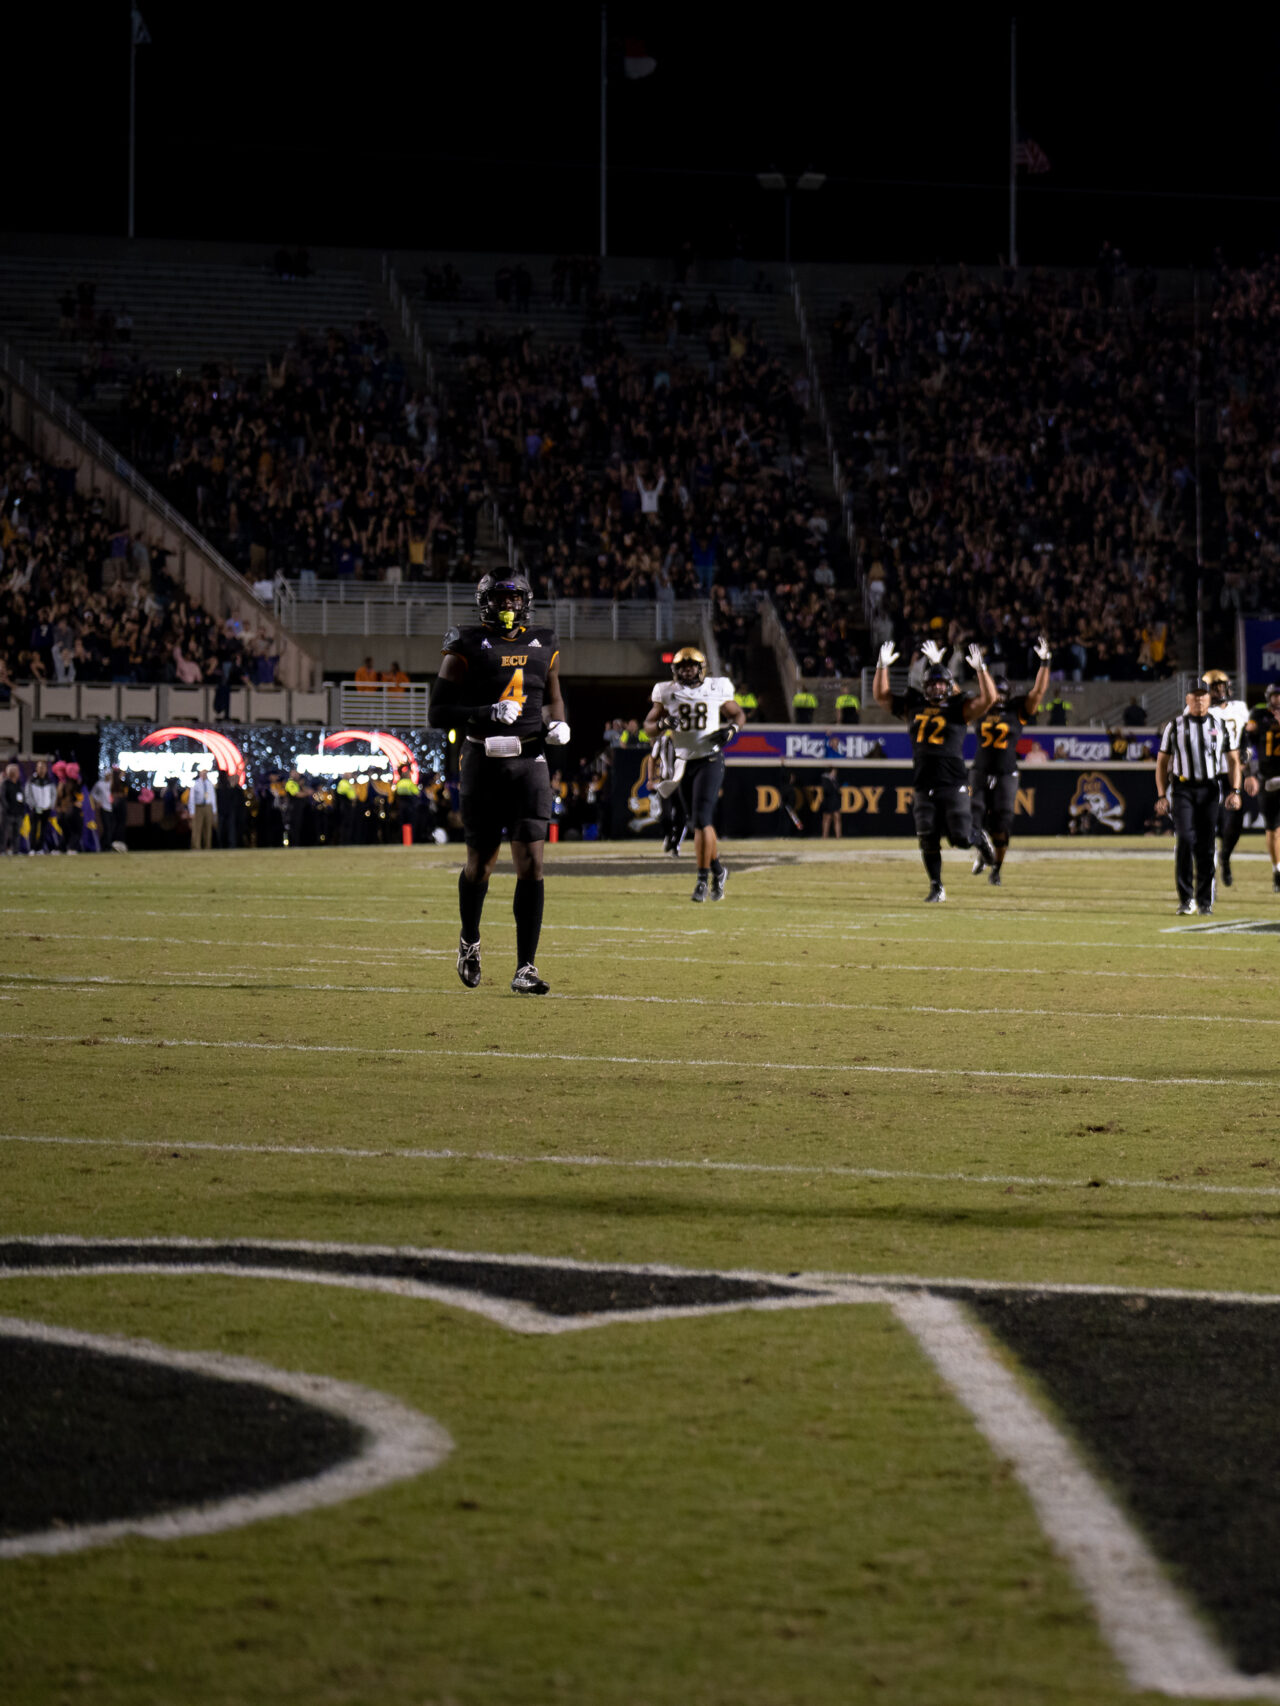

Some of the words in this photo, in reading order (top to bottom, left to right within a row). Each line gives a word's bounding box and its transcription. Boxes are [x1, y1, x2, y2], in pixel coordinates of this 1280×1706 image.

[500, 654, 528, 668] ECU
[499, 667, 528, 717] 4
[679, 702, 707, 731] 88
[914, 713, 947, 745] 72
[980, 721, 1010, 750] 52
